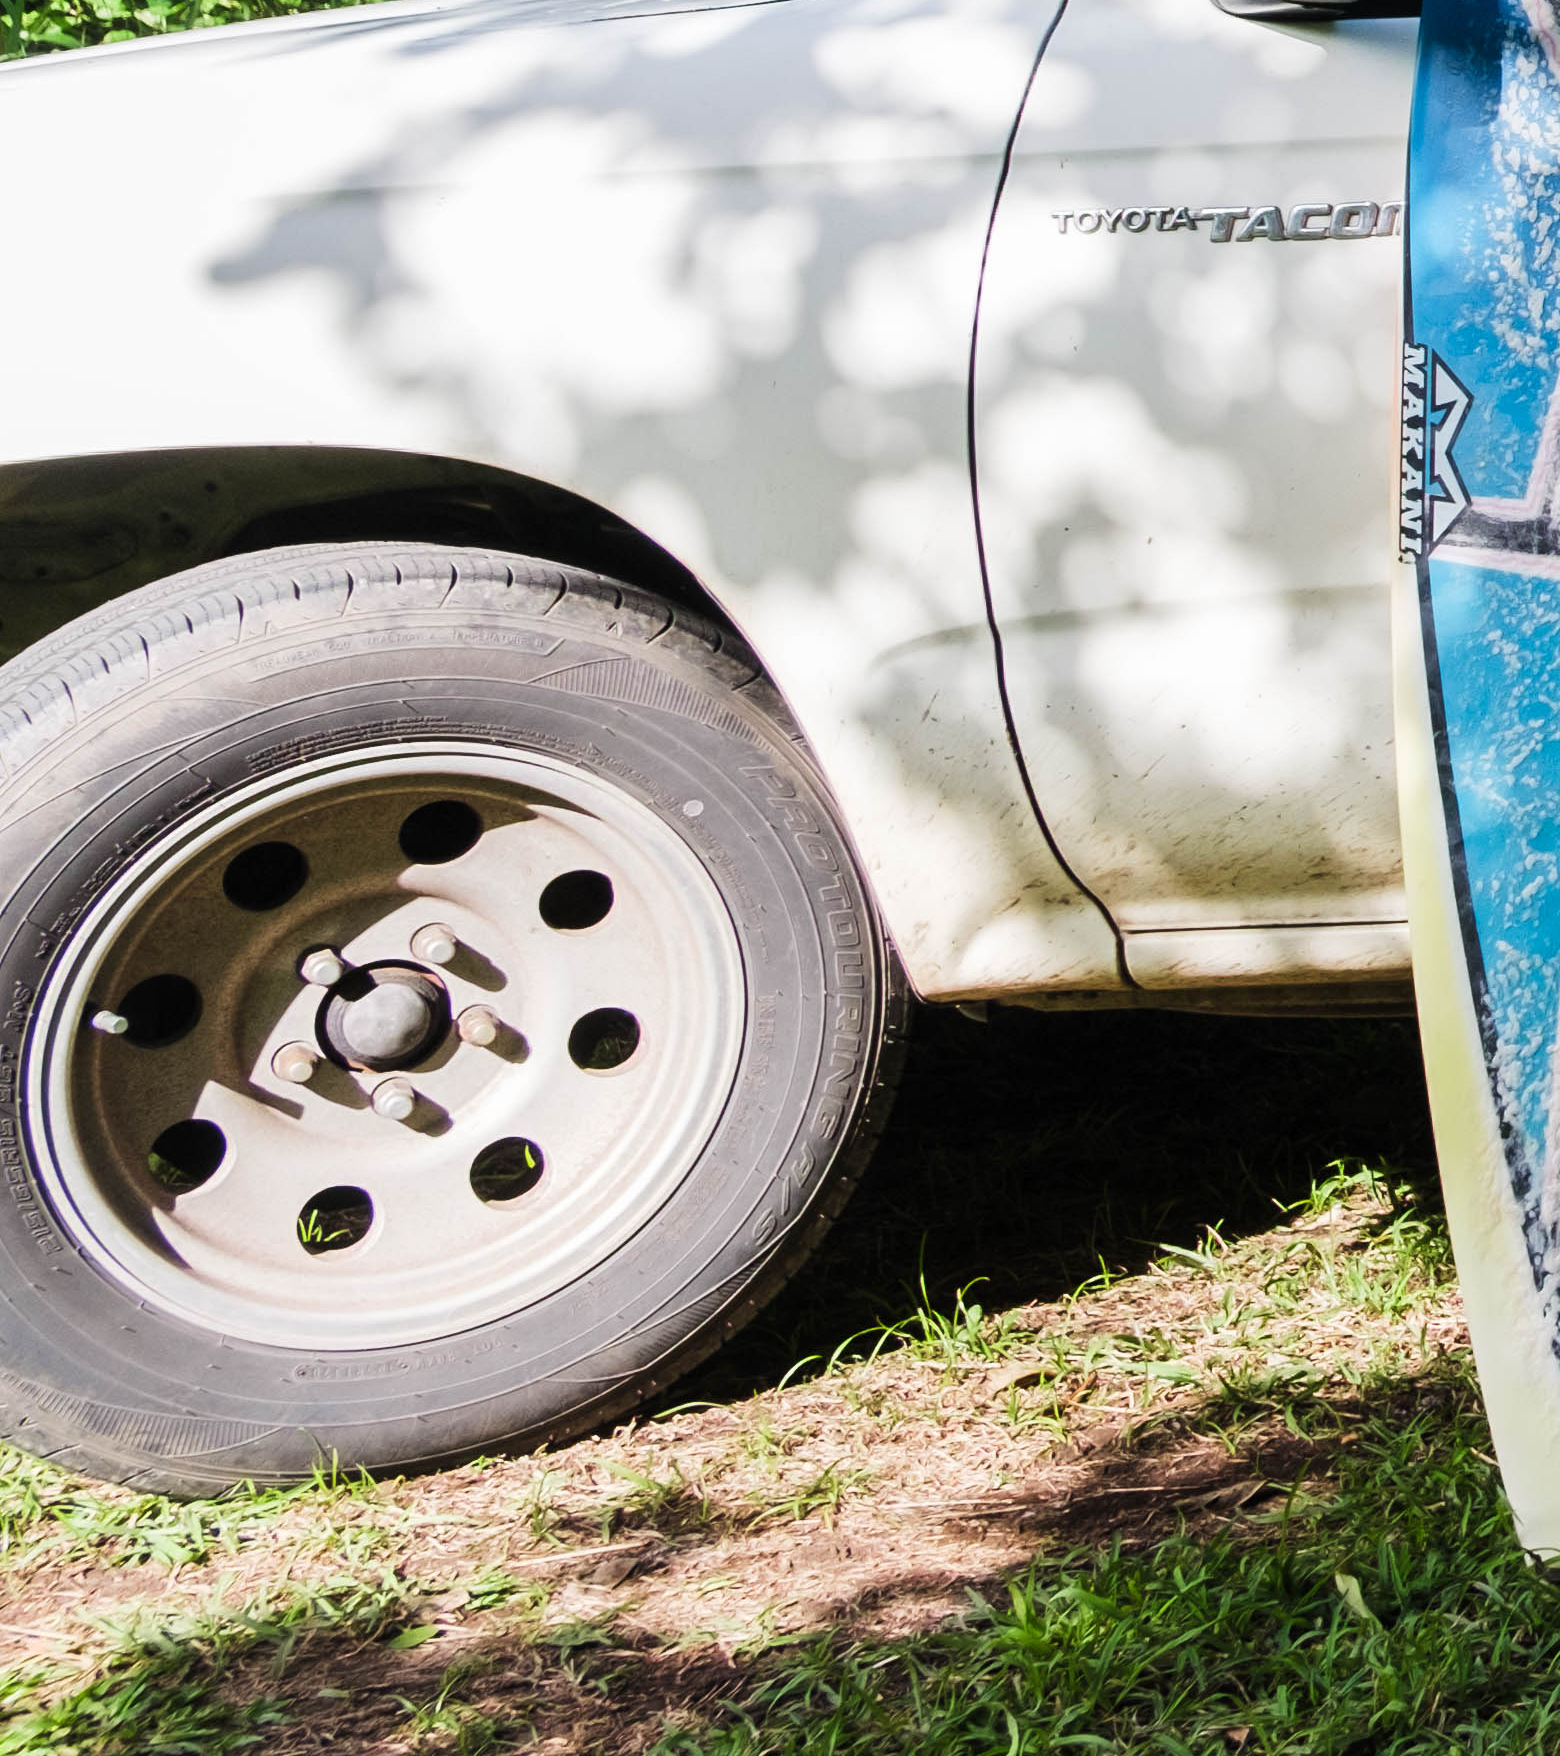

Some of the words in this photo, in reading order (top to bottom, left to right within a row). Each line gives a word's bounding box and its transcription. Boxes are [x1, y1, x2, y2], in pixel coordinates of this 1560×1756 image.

[1051, 206, 1198, 234] TOYOTA
[1401, 342, 1428, 559] MAKANI
[738, 763, 864, 1140] PROTOURING
